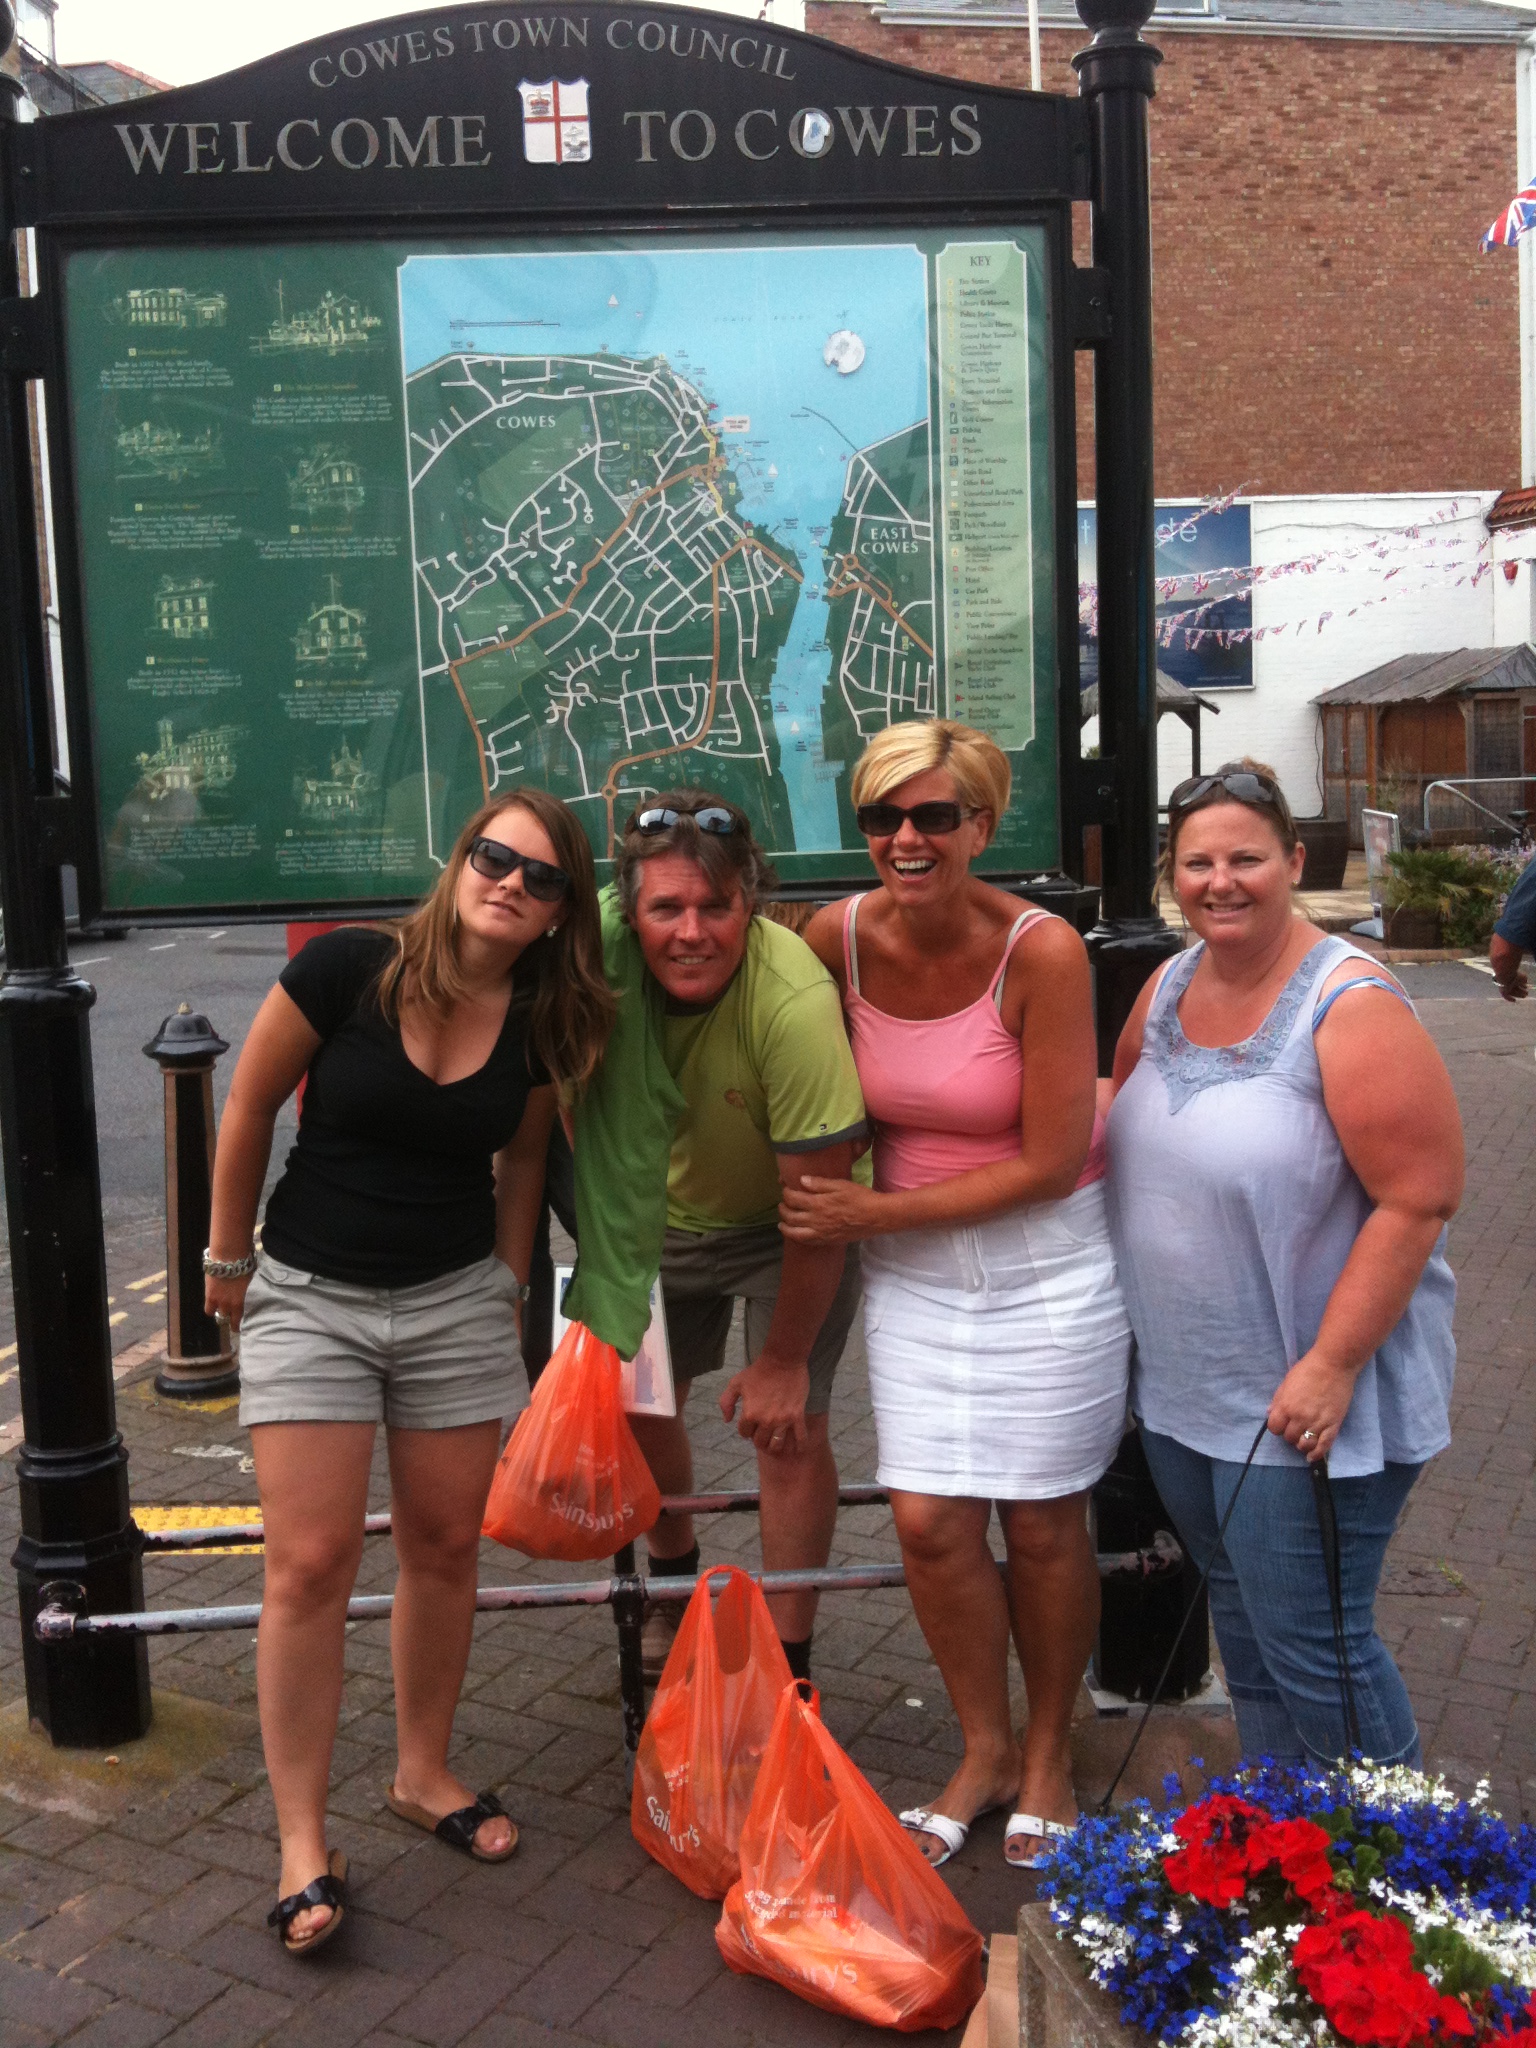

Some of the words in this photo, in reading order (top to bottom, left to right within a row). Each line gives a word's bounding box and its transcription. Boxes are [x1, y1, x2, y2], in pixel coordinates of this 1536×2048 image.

[308, 26, 455, 88] COWES
[464, 17, 589, 53] TOWN
[606, 18, 797, 81] COUNCIL
[623, 109, 716, 163] TO
[735, 104, 982, 161] COWES
[113, 115, 492, 175] WELCOME
[970, 256, 992, 266] KEY
[496, 415, 556, 429] COWES
[870, 527, 908, 541] EAST
[860, 541, 919, 555] COWES
